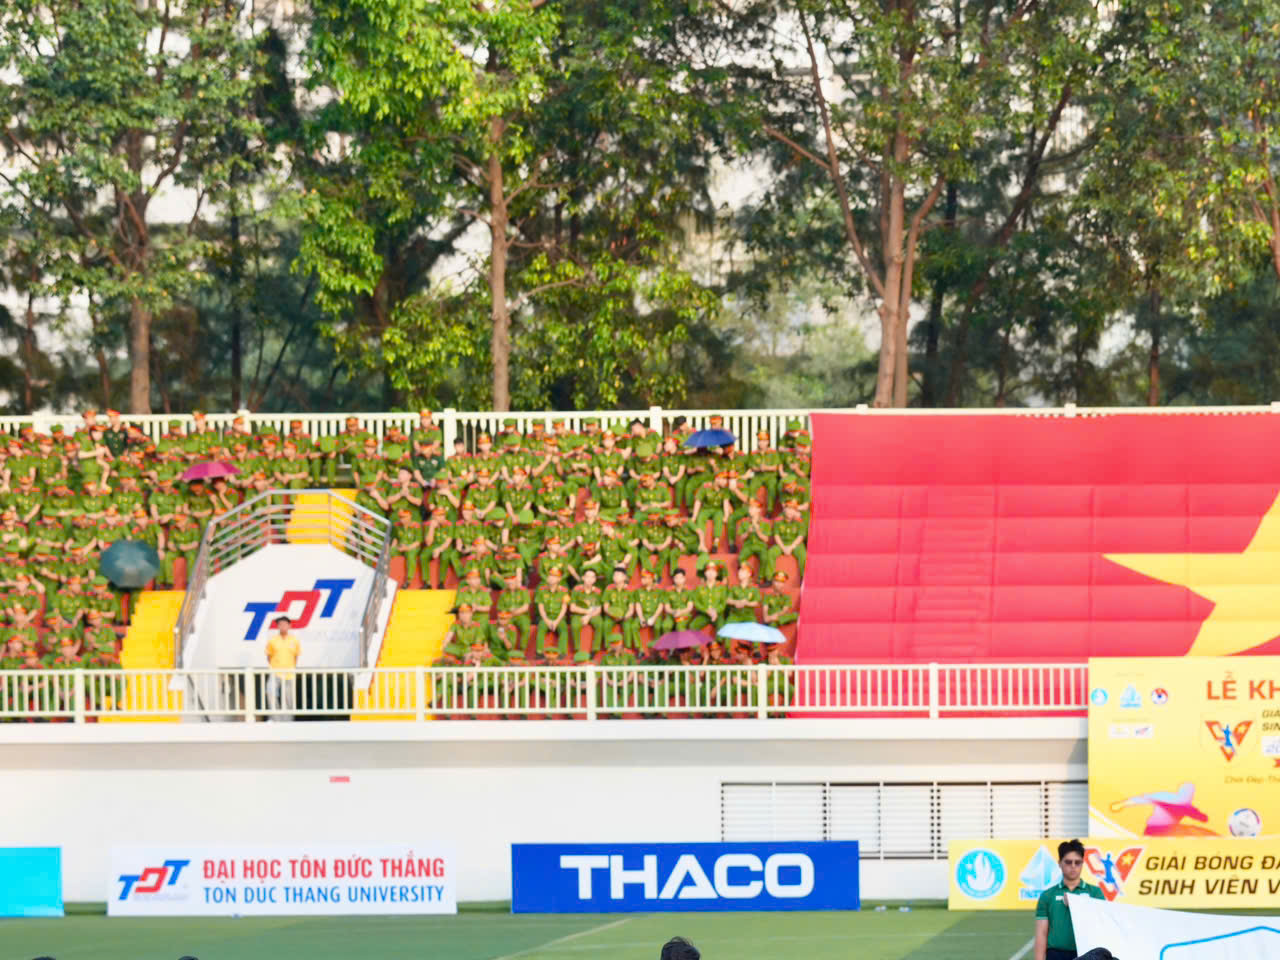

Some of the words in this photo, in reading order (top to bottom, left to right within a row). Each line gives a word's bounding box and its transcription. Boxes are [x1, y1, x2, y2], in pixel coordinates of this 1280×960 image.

[1206, 670, 1237, 700] LỄ
[202, 859, 235, 884] ĐẠI
[243, 858, 281, 884] HỌC
[289, 854, 327, 879] TÔN
[334, 853, 373, 879] ĐỨC
[380, 850, 445, 878] THẮNG
[560, 852, 815, 900] THACO
[203, 886, 235, 903] TON
[244, 886, 277, 903] DUC
[284, 886, 341, 903] THANG
[347, 885, 445, 903] UNIVERSITY
[1138, 879, 1196, 896] SINH
[1205, 875, 1258, 895] VIÊN
